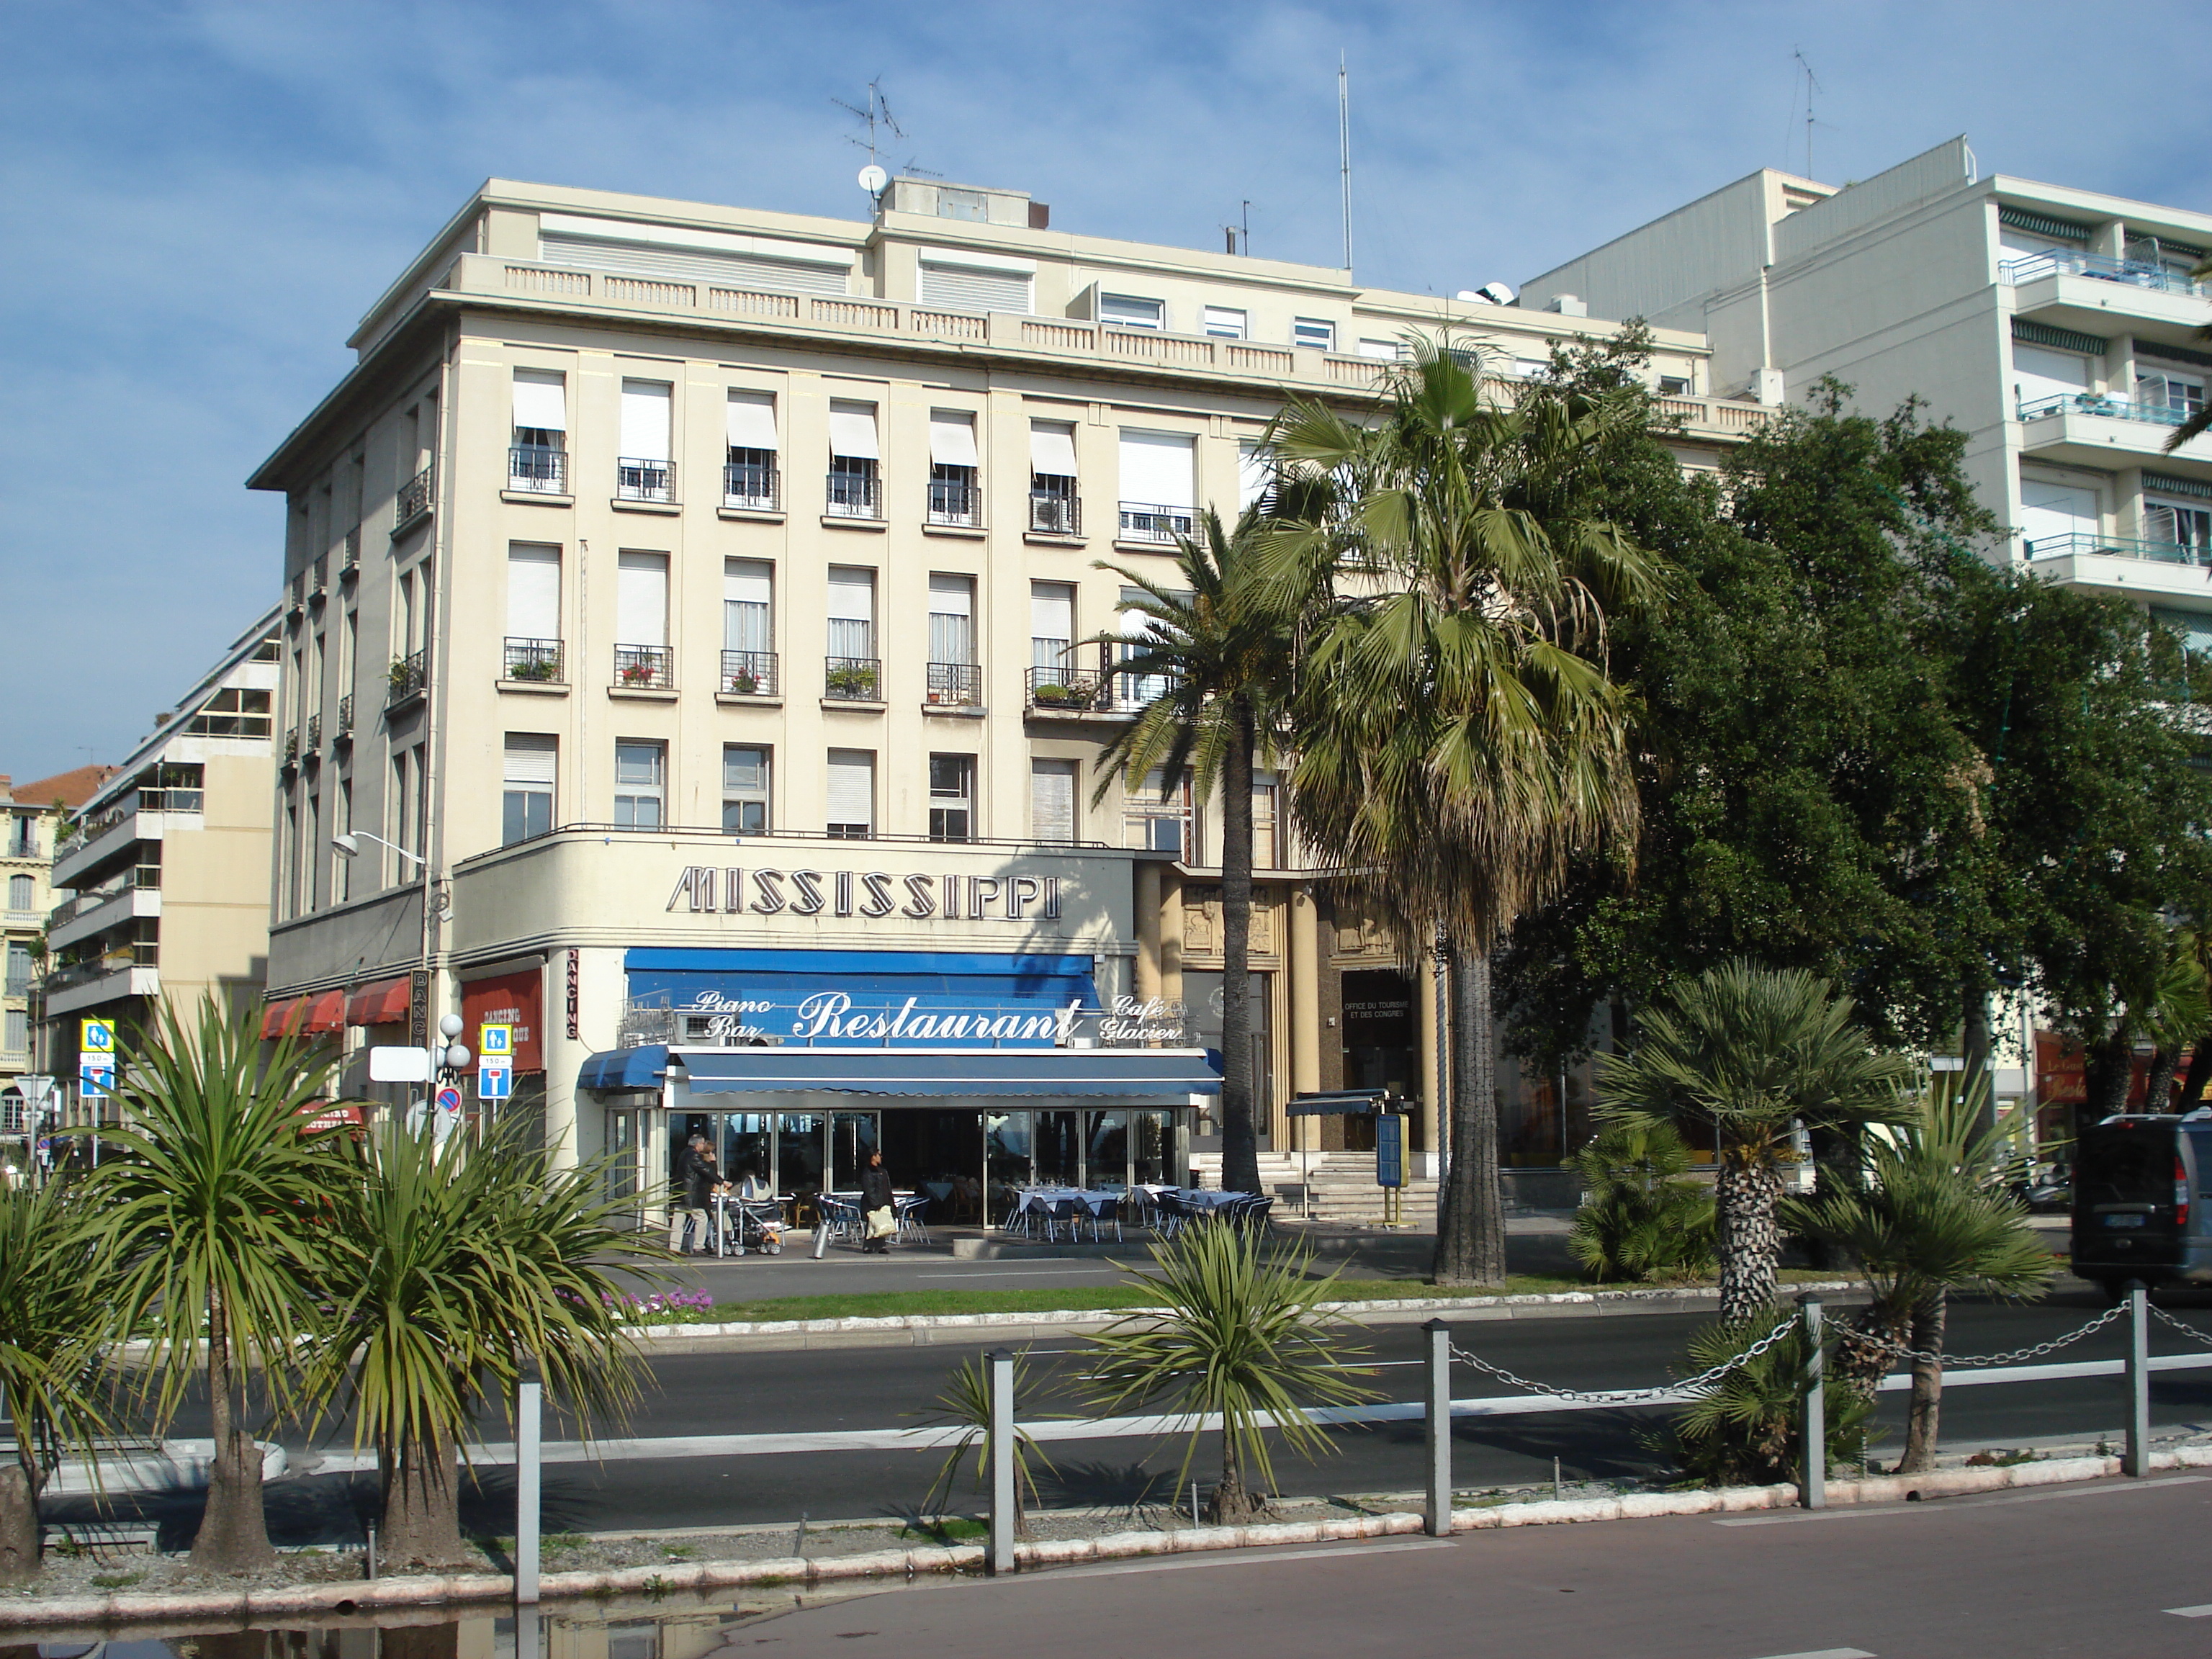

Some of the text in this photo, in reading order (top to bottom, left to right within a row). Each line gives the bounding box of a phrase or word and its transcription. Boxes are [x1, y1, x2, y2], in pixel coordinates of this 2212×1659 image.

[666, 866, 1061, 921] MISSISSIPPI
[566, 948, 578, 1038] DANCING
[691, 990, 775, 1013] Piano
[413, 973, 428, 1047] DANCI
[484, 1007, 521, 1024] DANCING
[792, 991, 1084, 1040] Restaurant
[1111, 995, 1169, 1025] Café
[703, 1014, 765, 1038] Bar
[1100, 1018, 1184, 1040] Glacier
